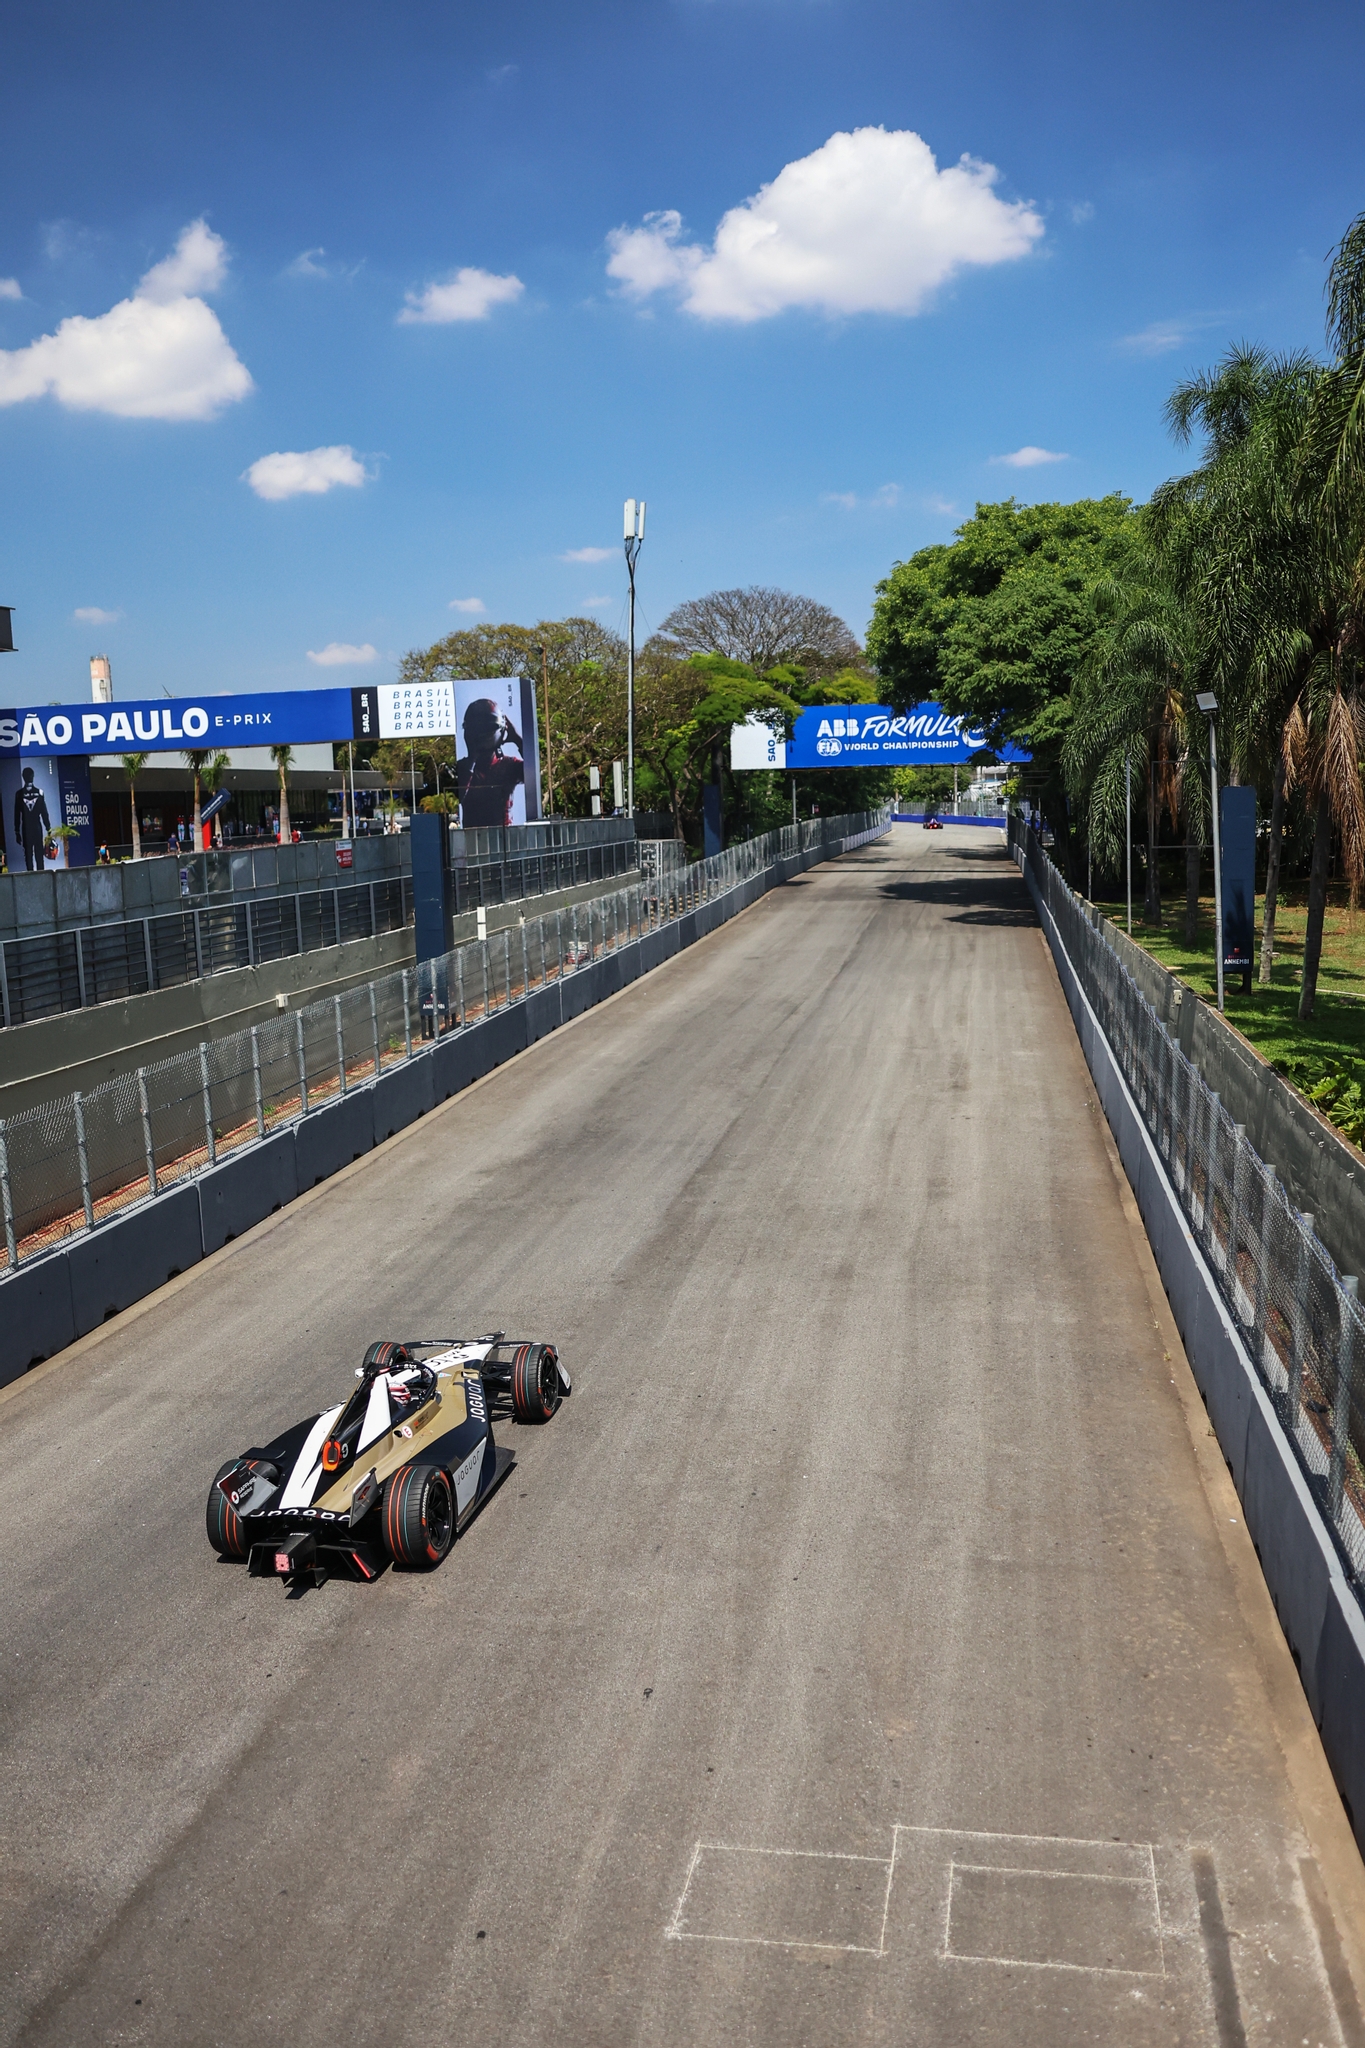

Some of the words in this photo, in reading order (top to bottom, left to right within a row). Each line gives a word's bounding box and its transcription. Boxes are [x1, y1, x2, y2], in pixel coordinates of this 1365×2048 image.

[393, 688, 450, 698] BRASIL
[393, 699, 450, 709] BRASIL
[361, 693, 370, 733] SAO_BR
[394, 709, 451, 720] BRASIL
[0, 713, 73, 747] SÃO
[81, 707, 209, 743] PAULO
[214, 713, 272, 727] E-PRIX
[394, 719, 452, 730] BRASIL
[816, 718, 859, 738] ABB
[818, 740, 841, 753] FIA
[844, 743, 879, 751] WORLD
[882, 740, 959, 749] CHAMPIONSHIP
[65, 791, 80, 804] SÃO
[66, 805, 88, 815] PAULO
[67, 816, 90, 826] E-PRIX
[341, 1443, 349, 1458] 9
